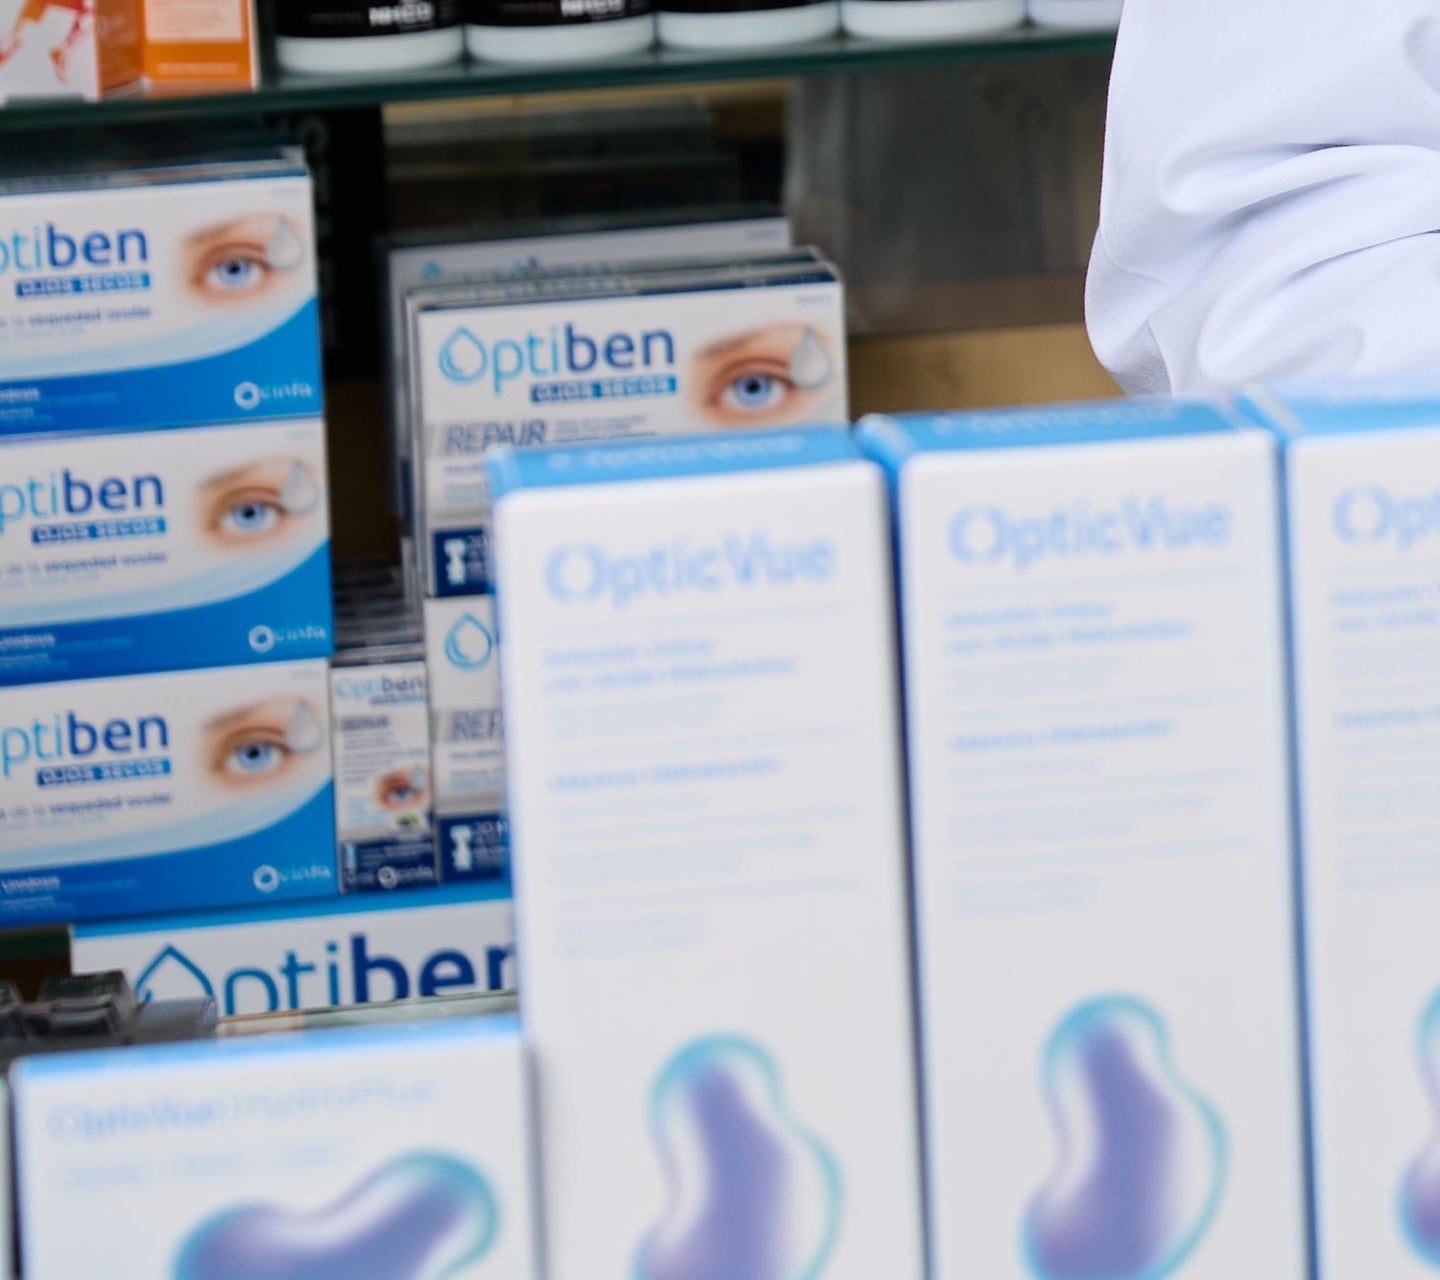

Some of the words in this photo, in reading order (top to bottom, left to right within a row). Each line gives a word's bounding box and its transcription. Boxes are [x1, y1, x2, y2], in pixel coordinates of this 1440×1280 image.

[438, 322, 676, 395] Optiben
[446, 419, 549, 454] REPAIR
[946, 494, 1236, 570] OpticVue
[544, 534, 839, 610] OpticVue
